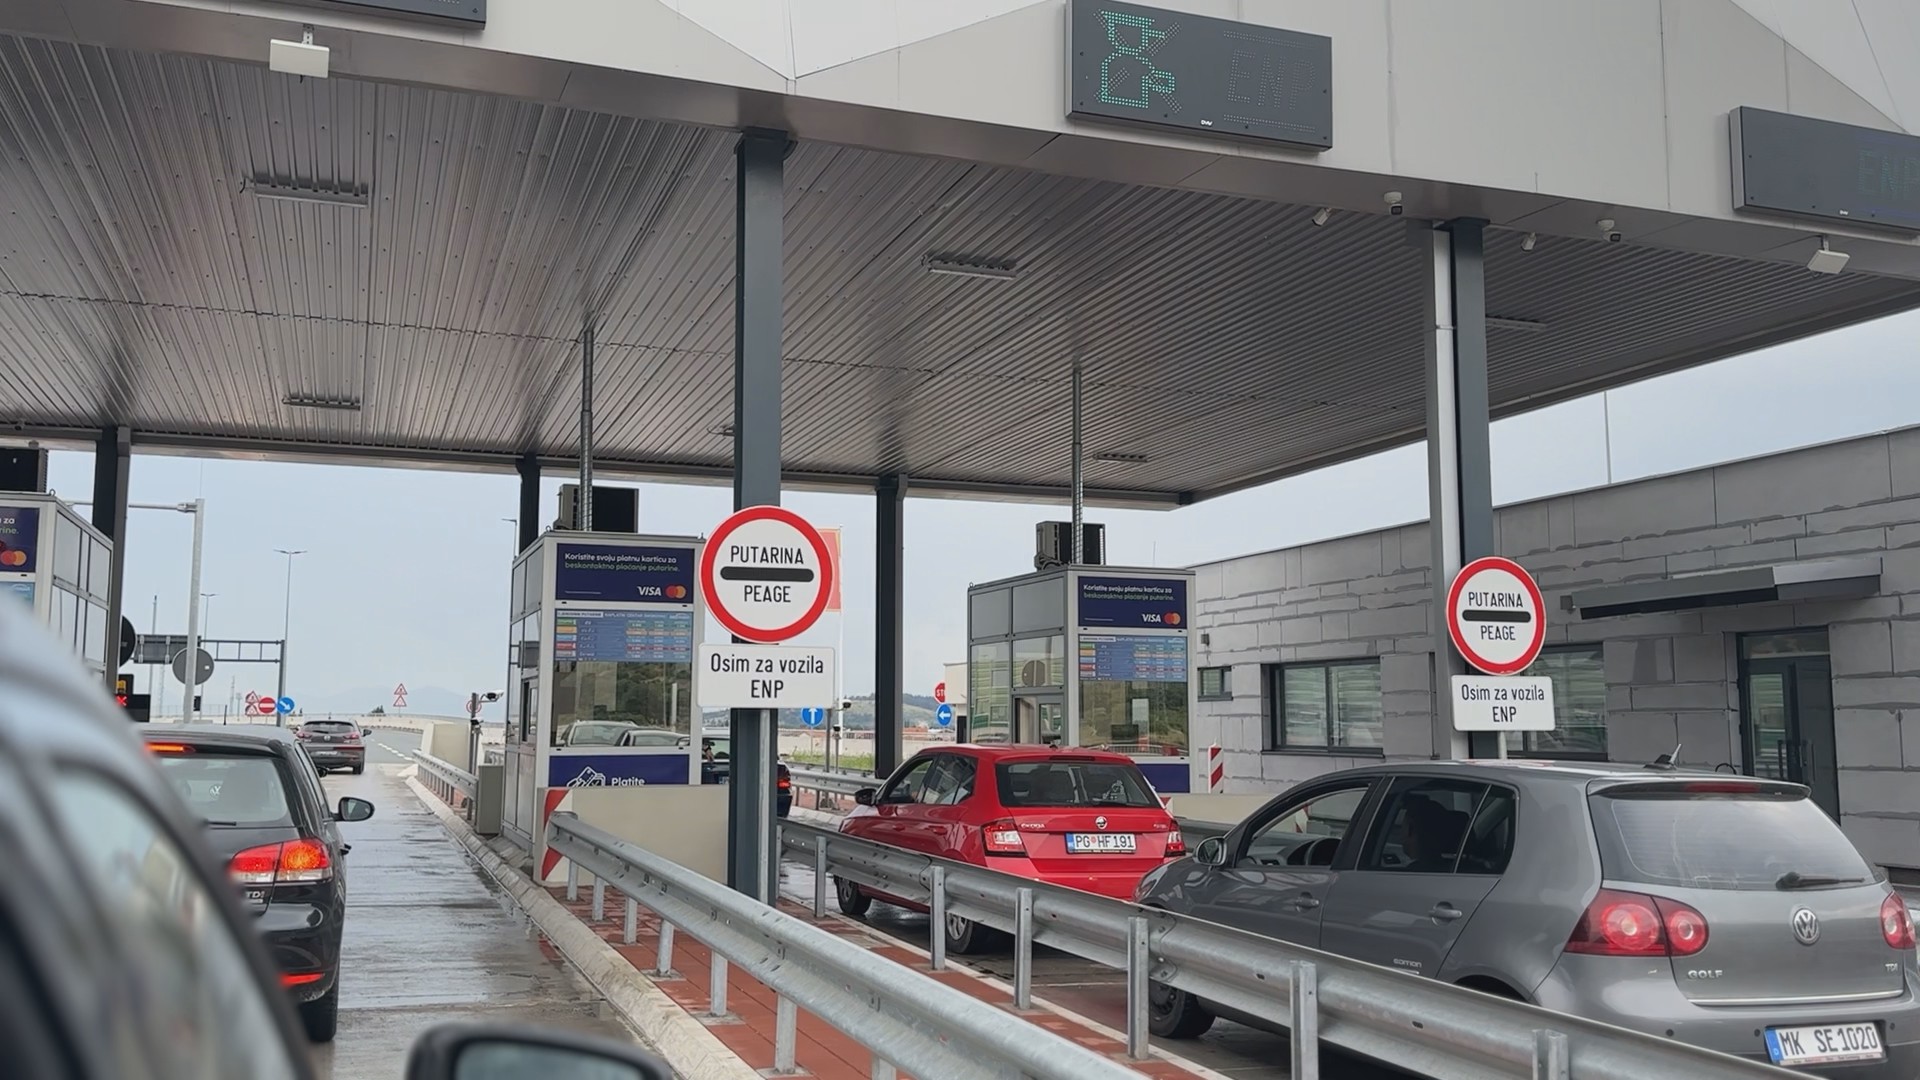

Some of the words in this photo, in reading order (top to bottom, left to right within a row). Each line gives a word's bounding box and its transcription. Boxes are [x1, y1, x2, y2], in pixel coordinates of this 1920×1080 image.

[1227, 48, 1315, 111] ENP
[564, 553, 595, 561] Koristite
[596, 554, 616, 562] svoju
[617, 554, 640, 562] platnu
[641, 555, 667, 563] karticu
[730, 545, 804, 565] PUTARINA
[564, 561, 614, 569] beskontaktno
[637, 586, 662, 596] VISA
[744, 585, 791, 603] PEAGE
[1468, 591, 1524, 608] PUTARINA
[1141, 613, 1162, 623] VISA
[1480, 625, 1516, 641] PEAGE
[711, 653, 750, 673] Osim
[755, 659, 773, 673] za
[779, 655, 824, 674] vozila
[751, 679, 784, 699] ENP
[1461, 684, 1490, 701] Osim
[1494, 689, 1507, 701] za
[1511, 684, 1545, 701] vozila
[1492, 706, 1517, 723] ENP
[611, 777, 645, 787] Platite
[1075, 835, 1090, 848] PG
[1688, 969, 1723, 979] GOLF
[1885, 963, 1898, 972] TDI
[1779, 1031, 1806, 1056] MK
